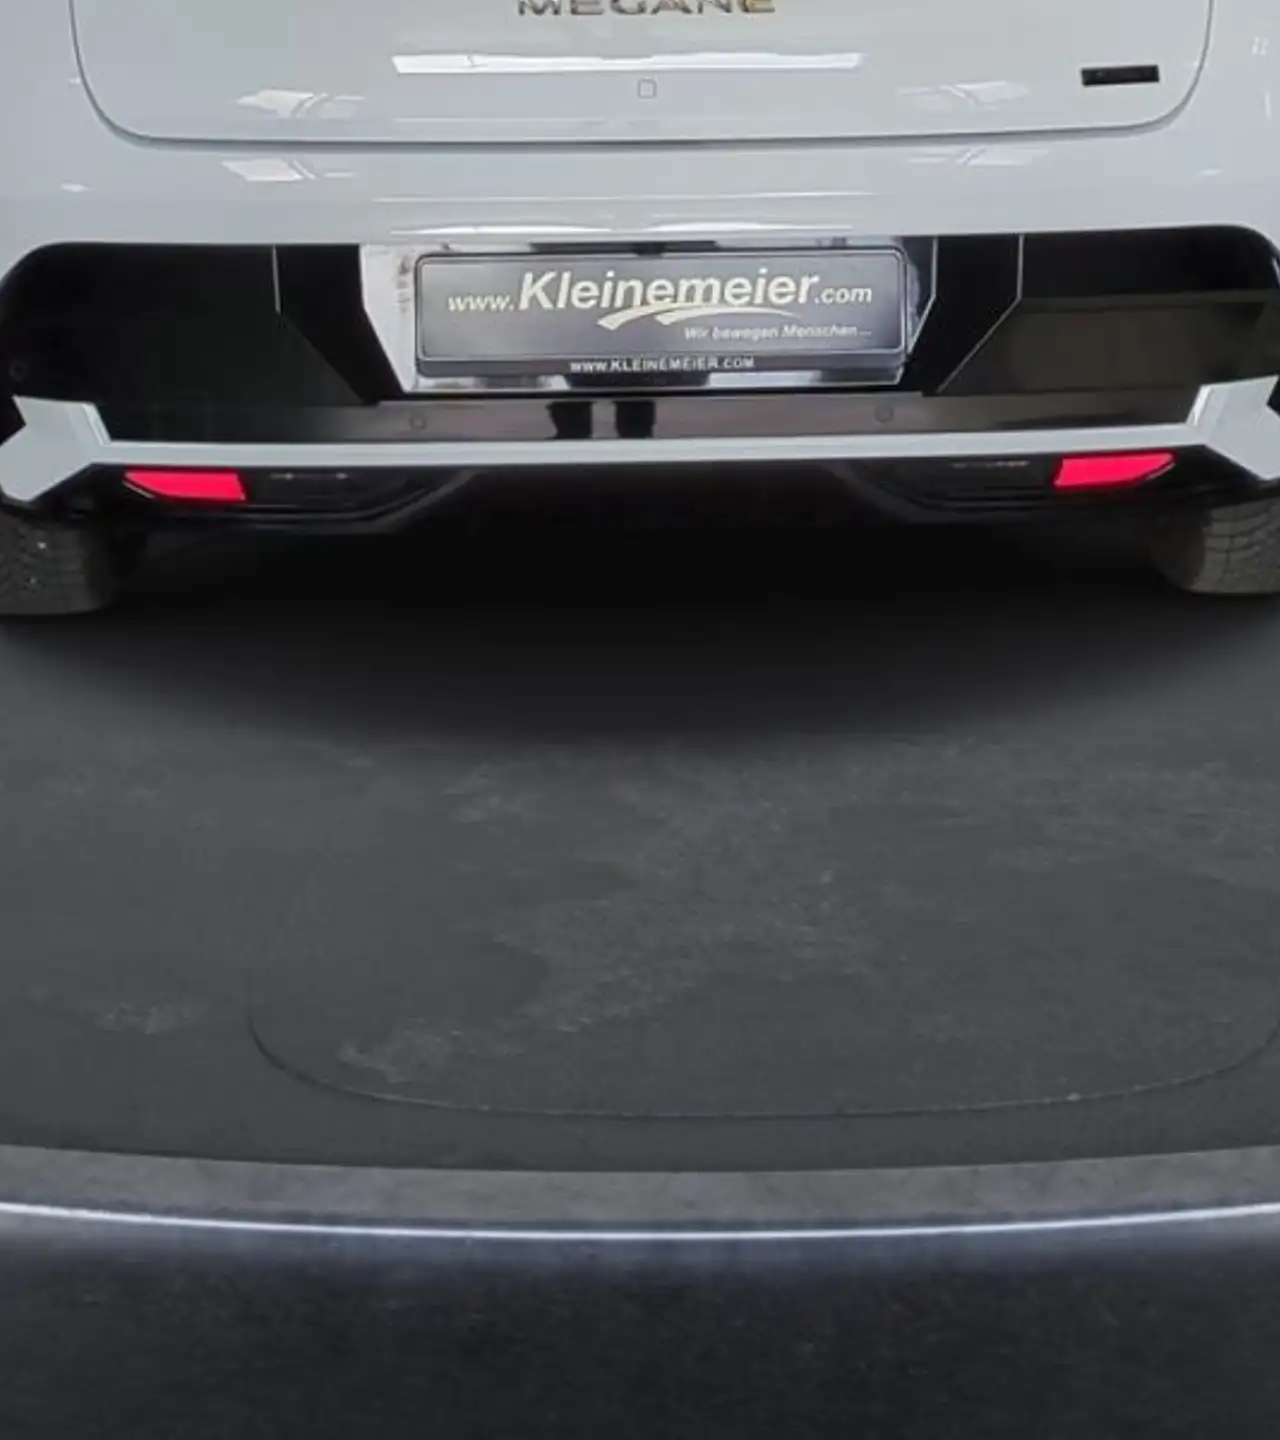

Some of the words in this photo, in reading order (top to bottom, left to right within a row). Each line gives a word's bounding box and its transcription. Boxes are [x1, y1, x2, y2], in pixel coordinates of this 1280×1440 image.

[447, 268, 872, 312] www.Kleinemeier.com
[684, 327, 708, 340] Wir
[711, 325, 779, 342] bewegen
